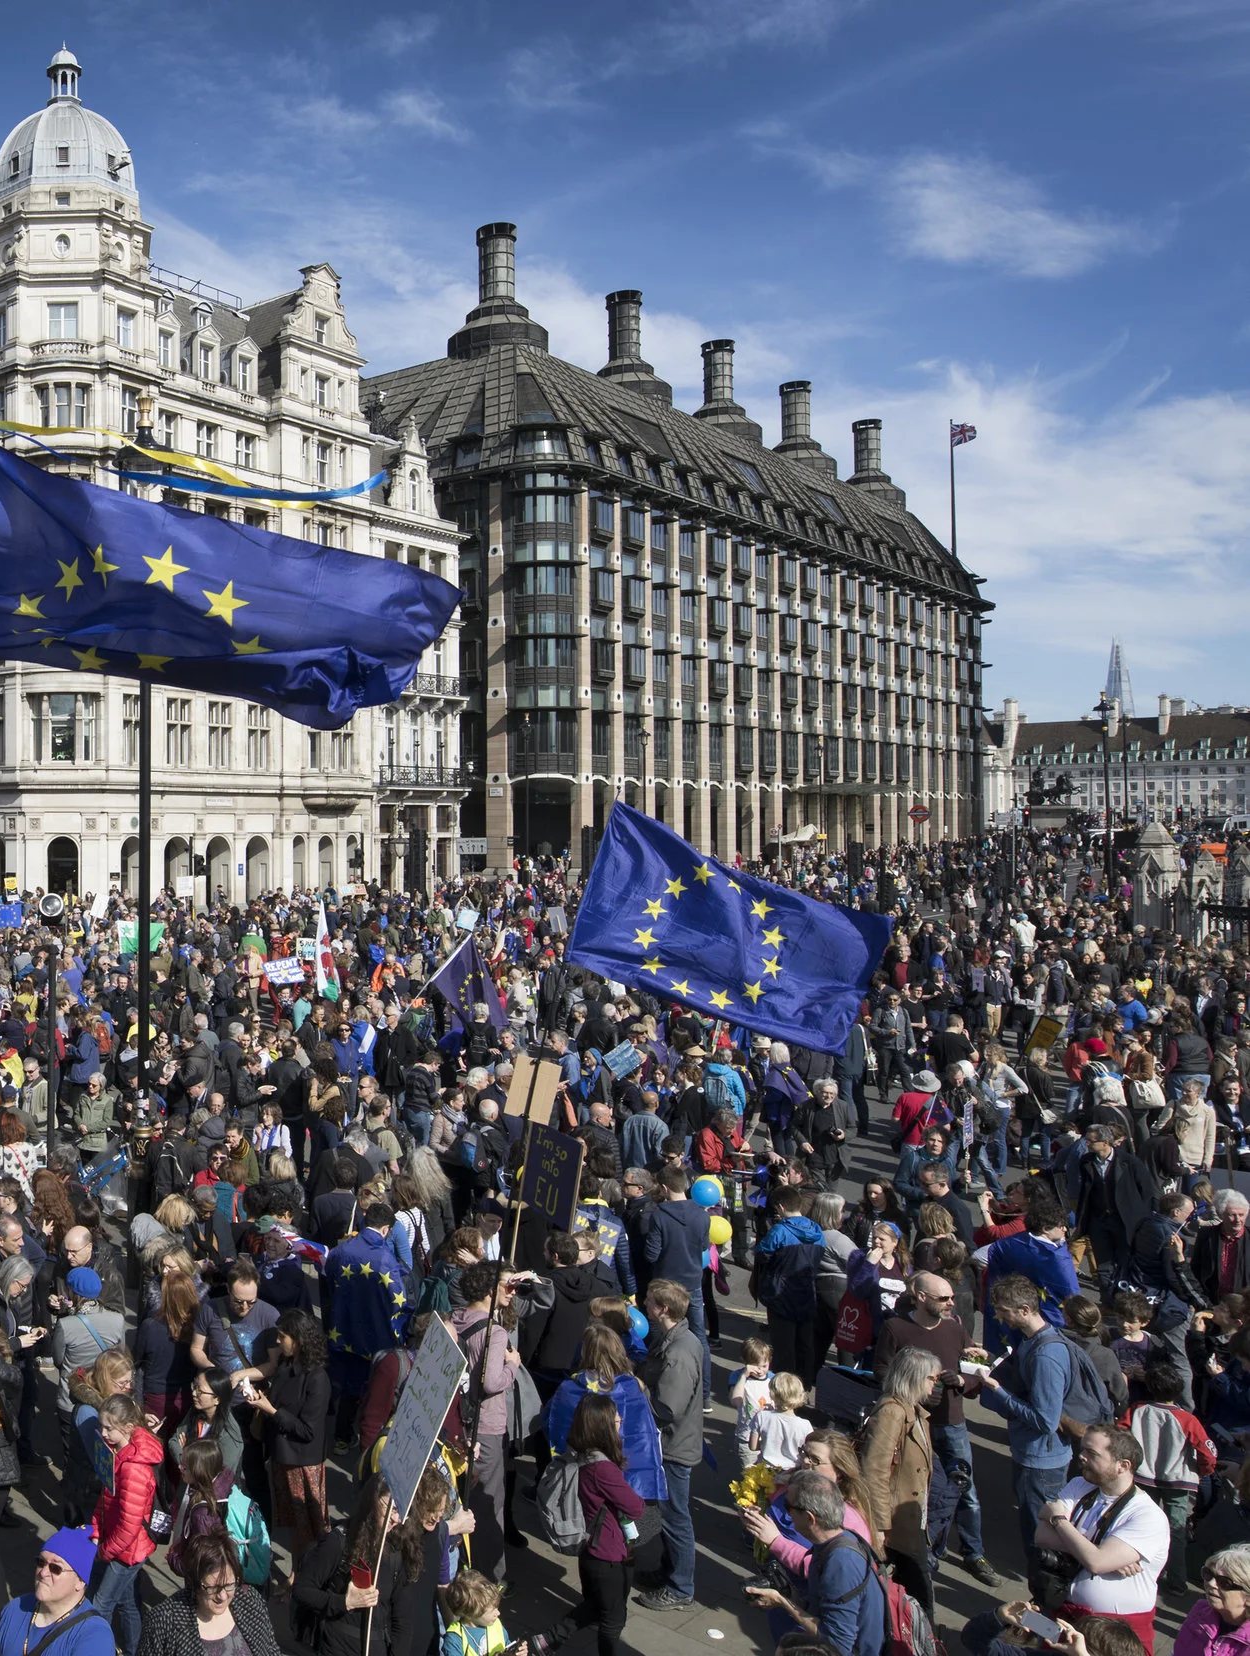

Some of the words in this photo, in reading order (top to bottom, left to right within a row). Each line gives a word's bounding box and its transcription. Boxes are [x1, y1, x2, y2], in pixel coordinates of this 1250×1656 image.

[264, 957, 298, 972] REPENT
[536, 1127, 554, 1150] I'm
[555, 1145, 568, 1160] so
[541, 1155, 559, 1178] into
[534, 1176, 559, 1217] EU
